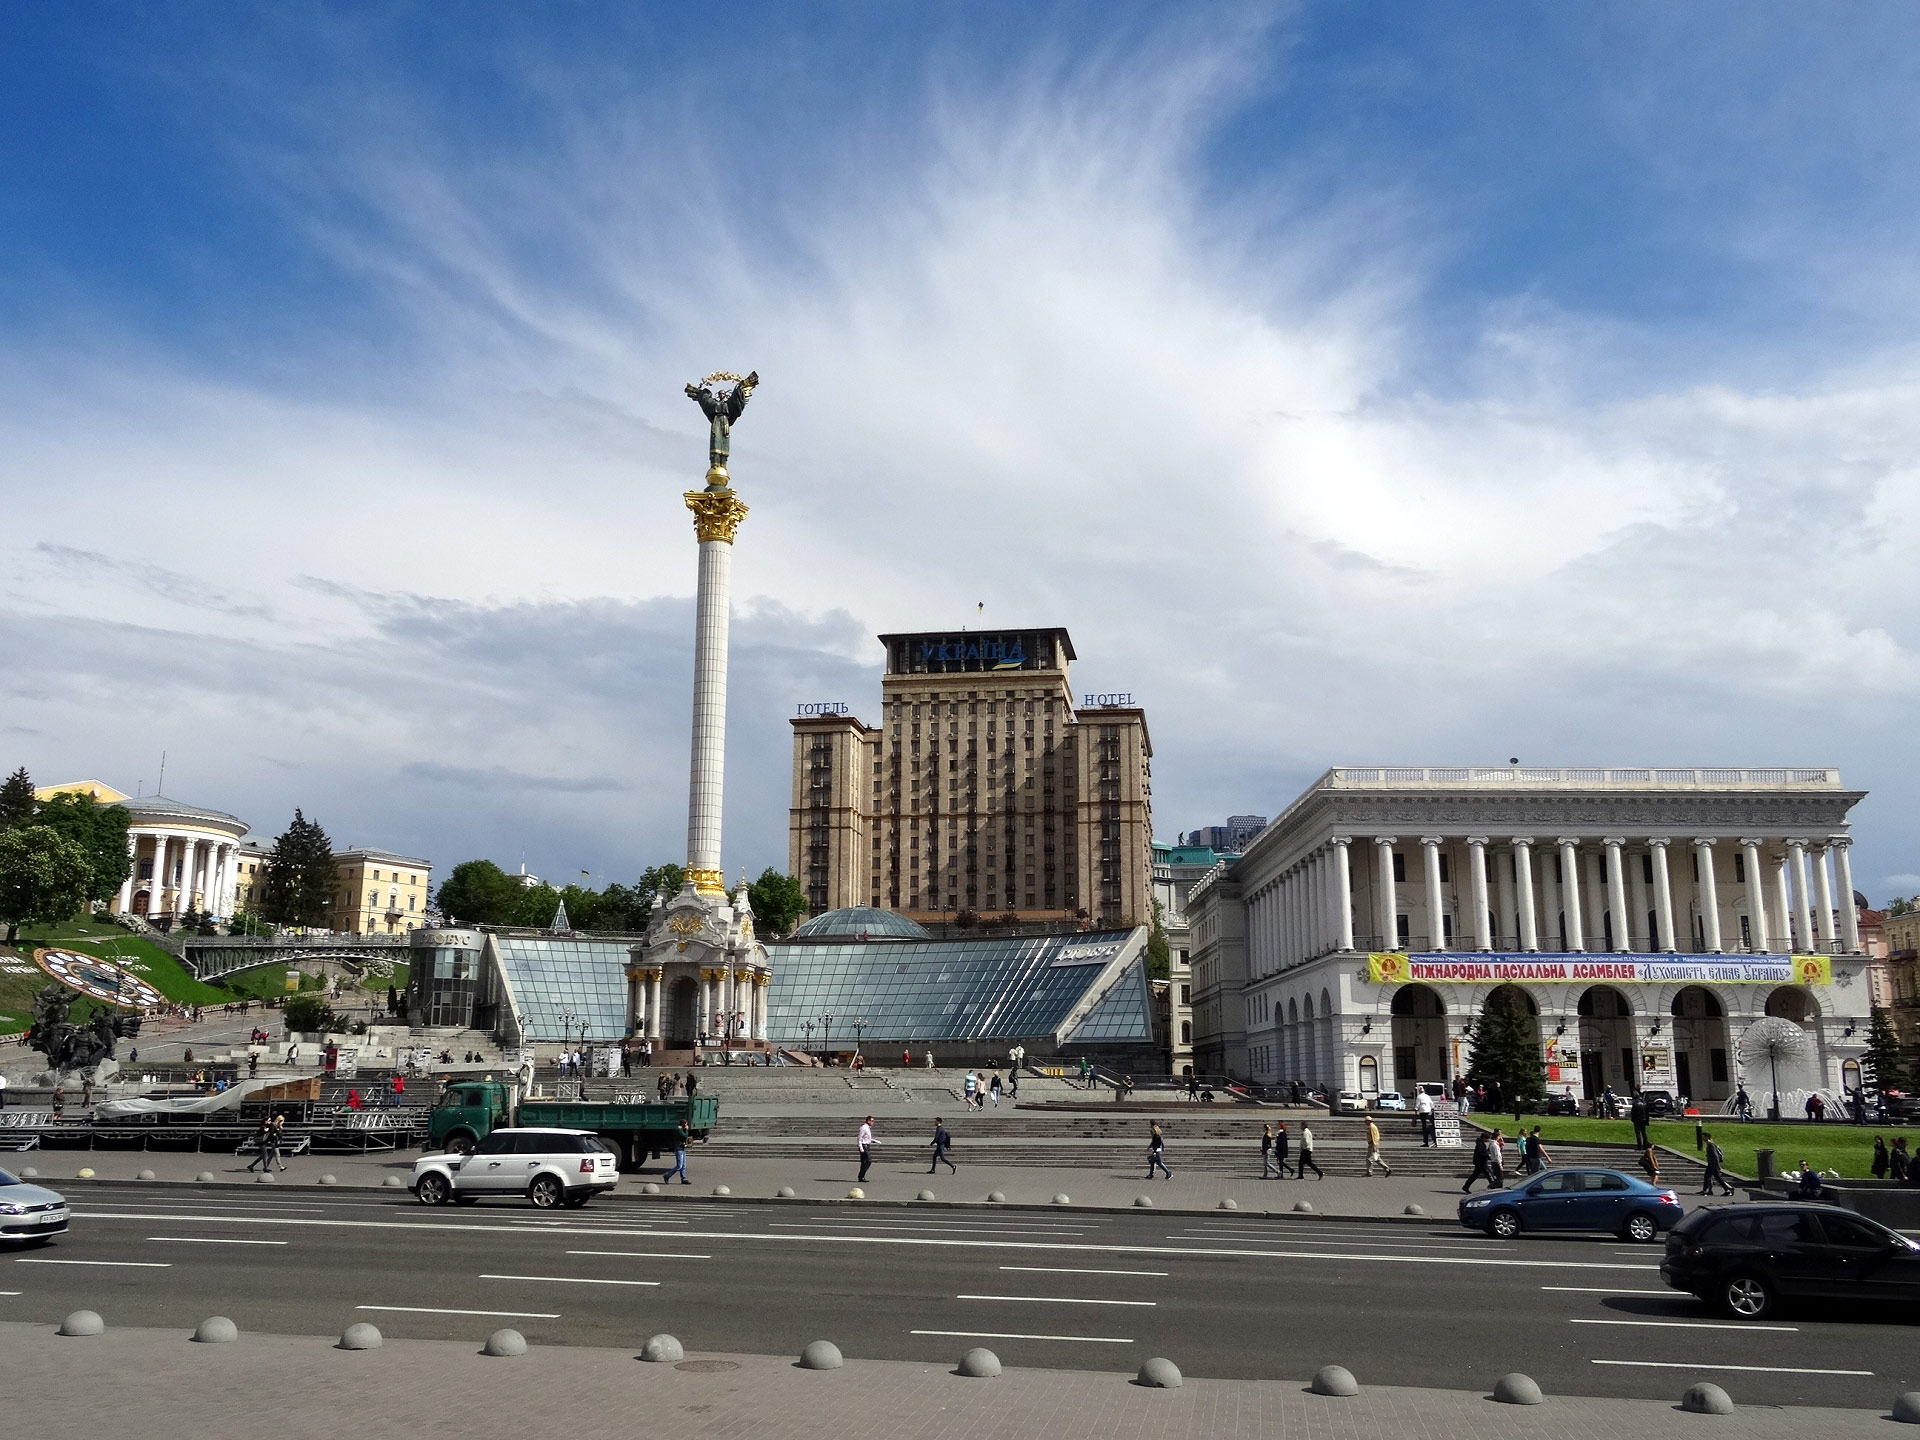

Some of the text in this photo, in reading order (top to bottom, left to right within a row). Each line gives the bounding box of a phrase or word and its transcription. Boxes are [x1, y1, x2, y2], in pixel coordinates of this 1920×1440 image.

[920, 640, 1024, 662] УКРАЇНА
[1084, 693, 1136, 706] HOTEL
[797, 702, 849, 714] ГОТЕЛЬ
[1411, 964, 1491, 980] МІЖНАРОДНА
[1493, 964, 1566, 979] ПАСХАЛЬНА
[1572, 964, 1635, 979] АСАМБЛЕЯ
